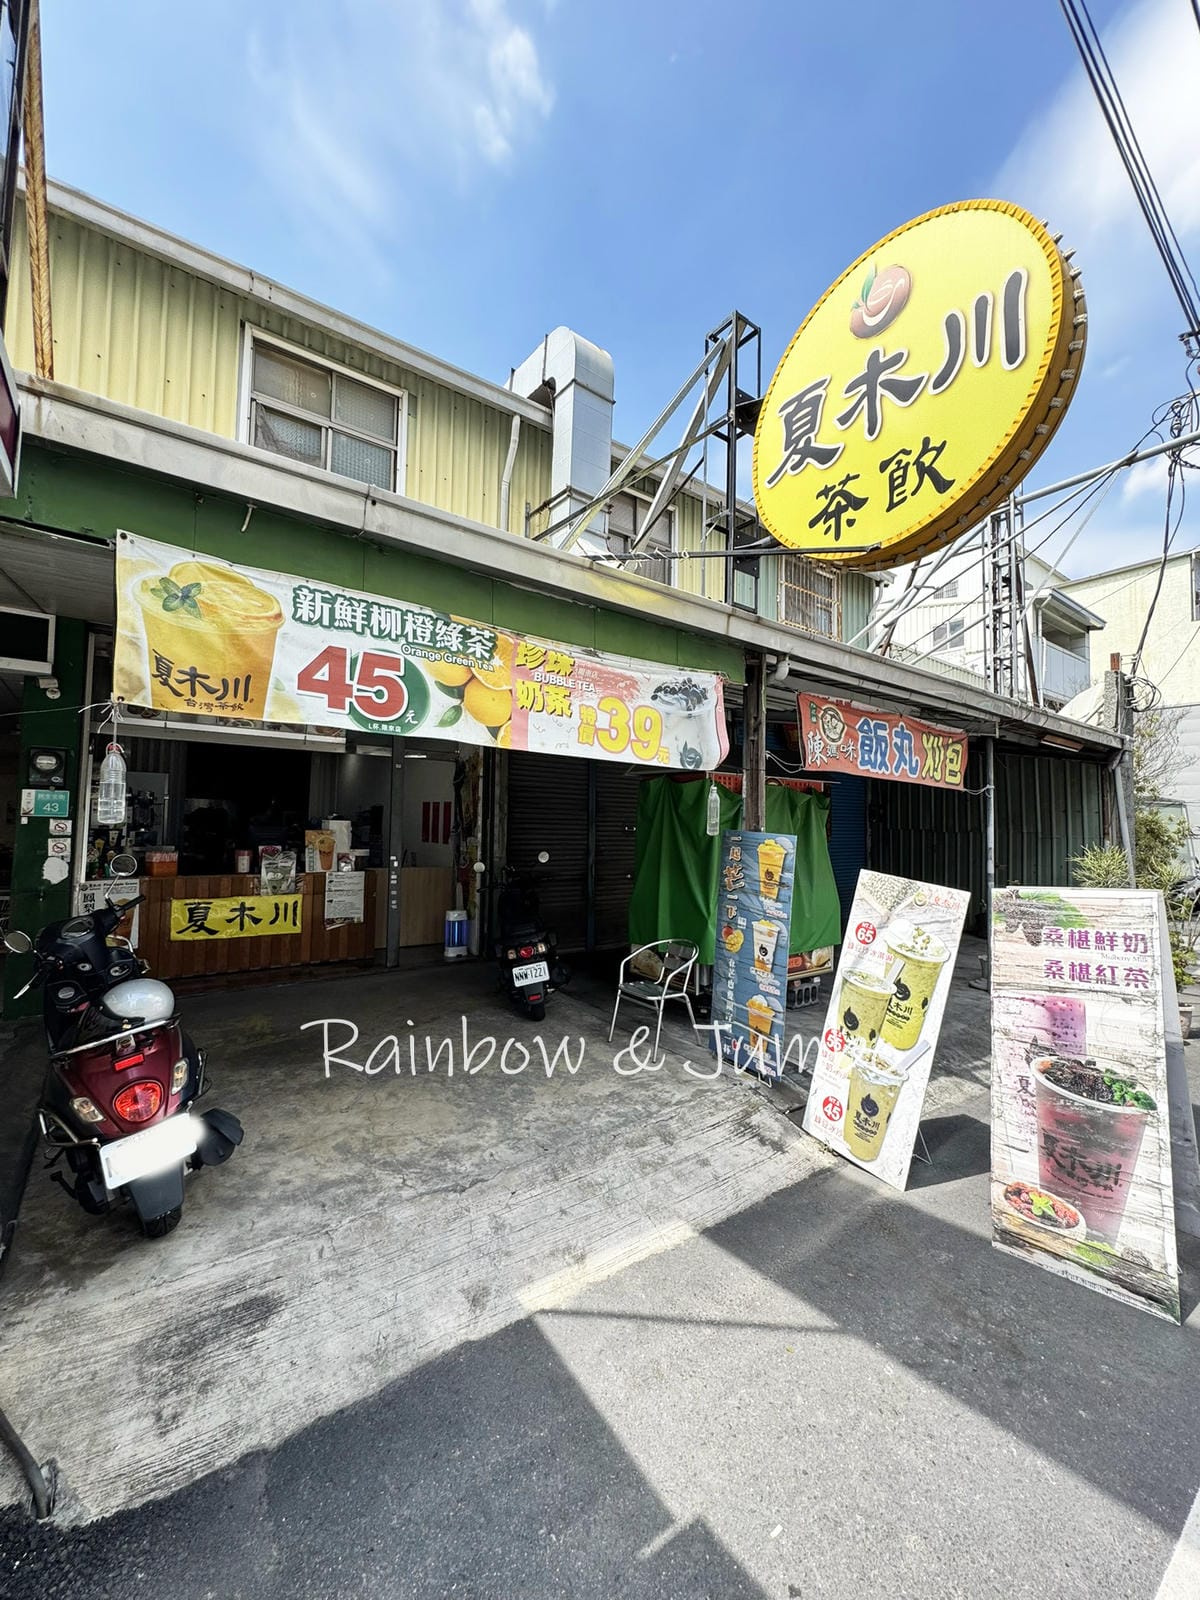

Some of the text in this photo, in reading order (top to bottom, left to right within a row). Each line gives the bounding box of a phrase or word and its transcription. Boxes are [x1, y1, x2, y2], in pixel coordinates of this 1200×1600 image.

[766, 268, 1028, 488] 夏木川
[808, 437, 956, 542] 茶飲
[293, 585, 497, 660] 新鮮柳橙綠茶
[152, 648, 252, 702] 夏木川
[402, 643, 495, 673] Orange Green Tea
[515, 641, 576, 677] 珍珠
[296, 645, 405, 722] 45
[516, 679, 573, 717] 奶茶
[534, 671, 597, 693] BUBBLE TEA
[404, 709, 420, 726] 元
[578, 704, 597, 746] 特價
[597, 696, 663, 761] 39
[657, 747, 671, 764] 元
[857, 716, 920, 779] 飯丸
[921, 732, 964, 786] 刈包
[42, 802, 59, 812] 43
[176, 900, 299, 936] 夏木川
[857, 927, 874, 943] 65
[1043, 927, 1148, 955] 桑椹鮮奶
[1044, 959, 1149, 989] 桑椹紅茶
[824, 1103, 840, 1121] 45
